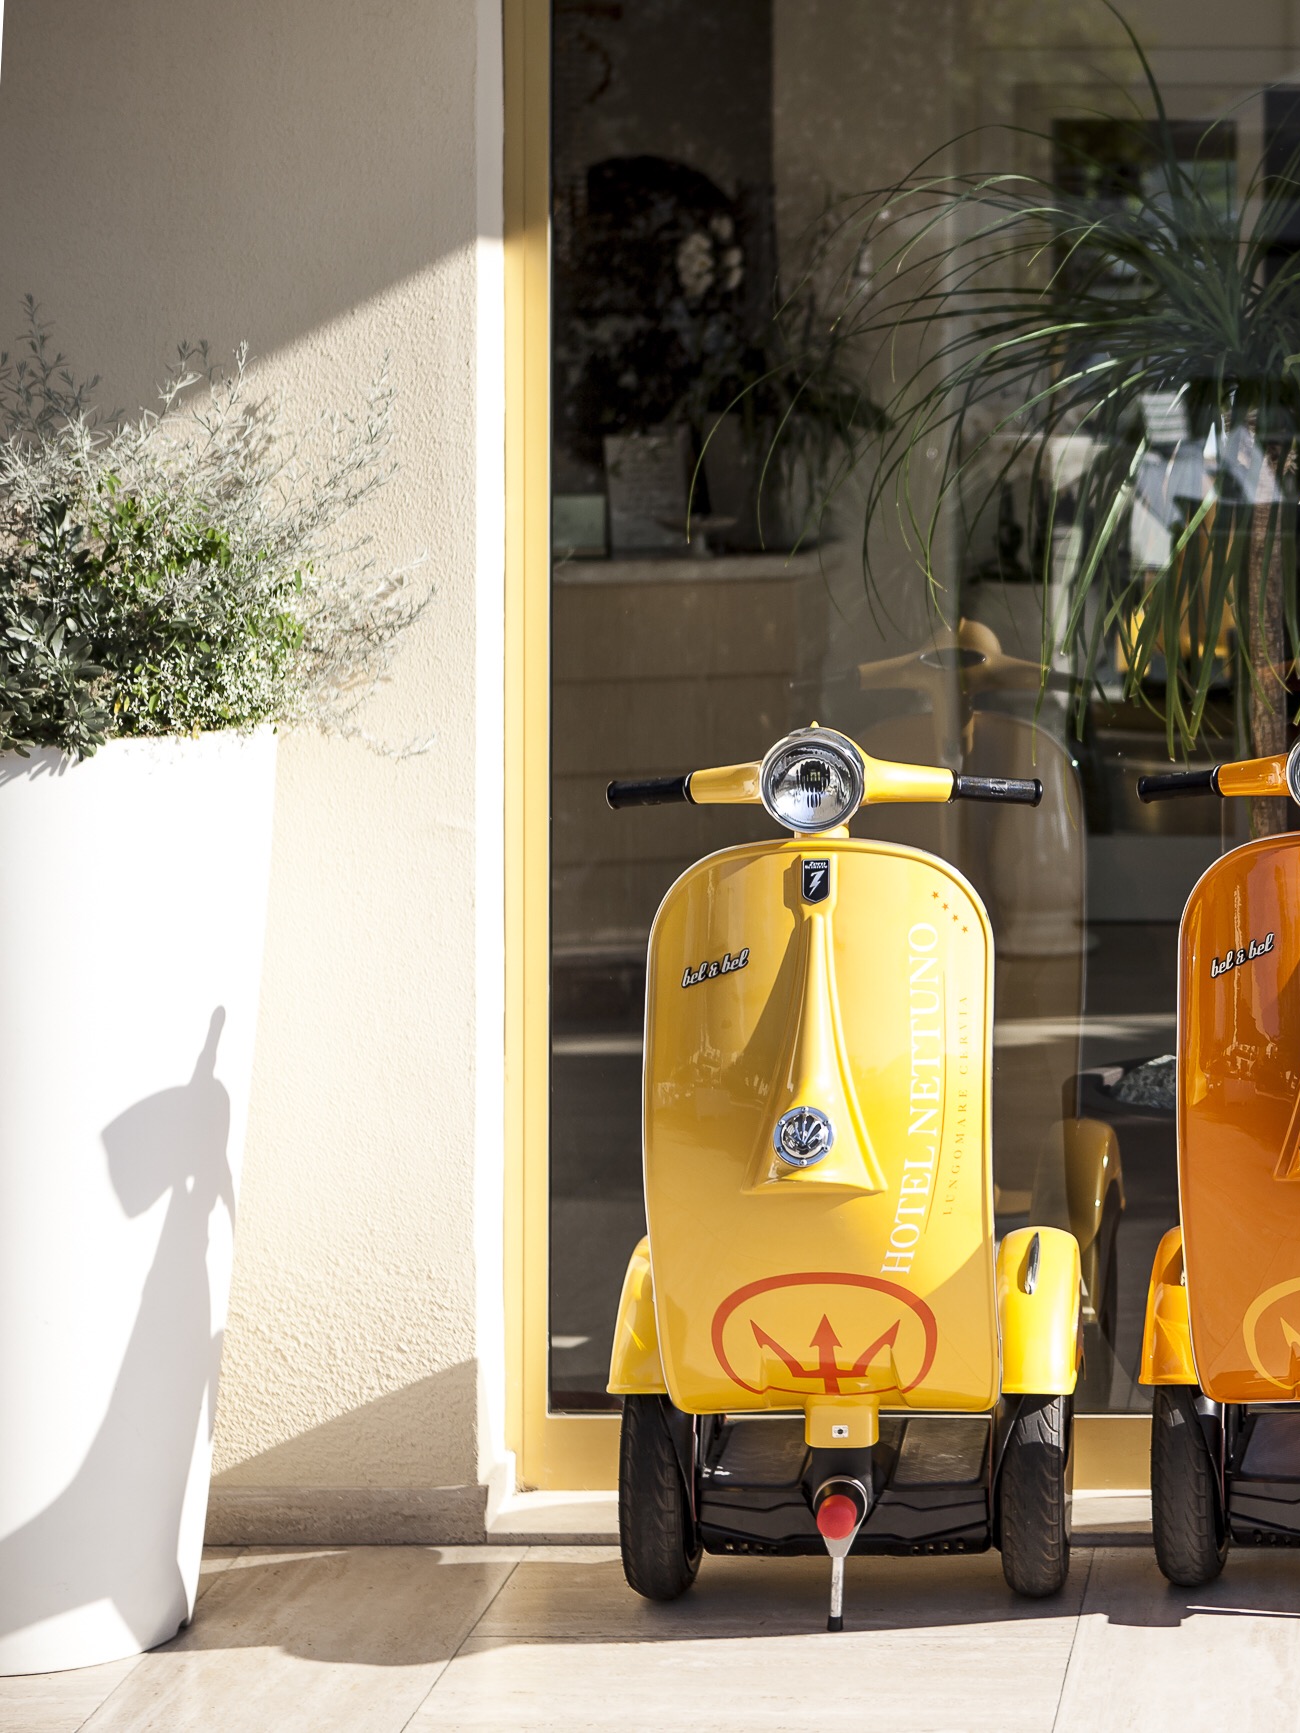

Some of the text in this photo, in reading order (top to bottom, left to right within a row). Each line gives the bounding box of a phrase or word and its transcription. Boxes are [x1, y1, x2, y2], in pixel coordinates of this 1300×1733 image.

[681, 948, 750, 988] bel & bel
[1210, 932, 1275, 978] bel & bel
[880, 922, 941, 1274] HOTEL NETTUNO
[943, 996, 969, 1216] LUNGOMARE CERVIA
